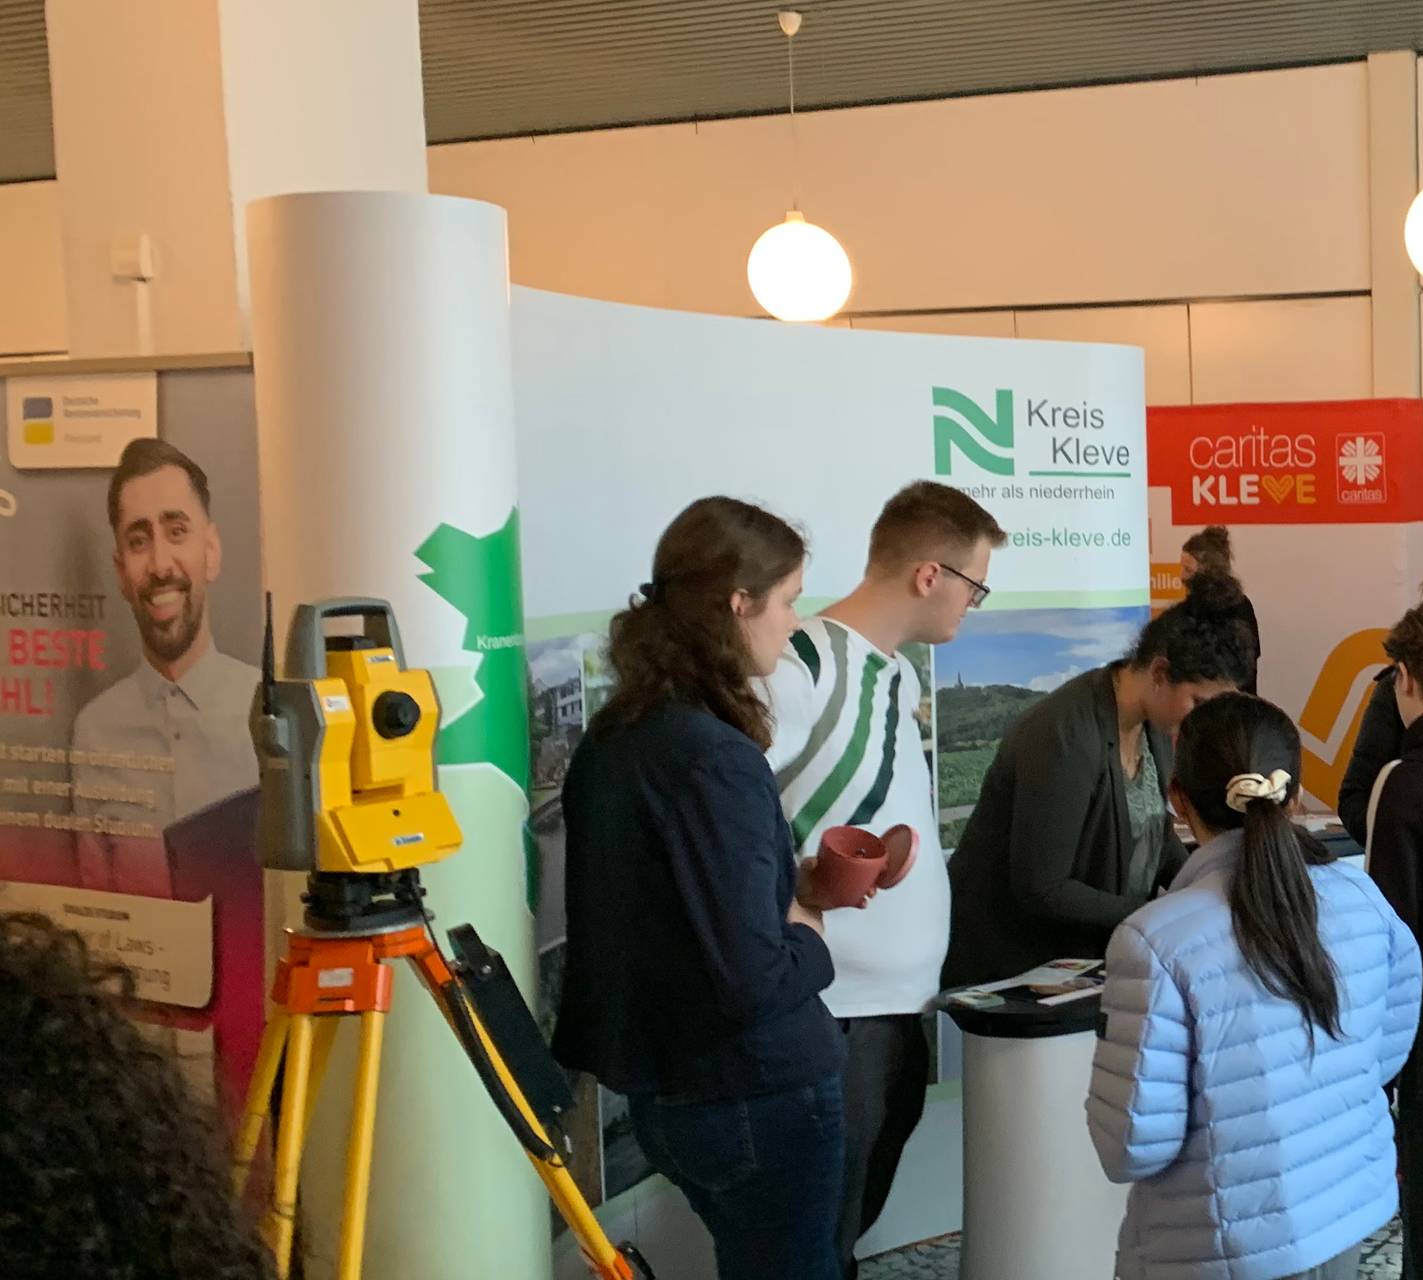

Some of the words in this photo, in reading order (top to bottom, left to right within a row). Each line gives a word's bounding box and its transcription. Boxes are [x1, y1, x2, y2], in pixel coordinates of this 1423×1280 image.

[1026, 398, 1105, 429] Kreis
[1051, 436, 1131, 466] Kleve
[1190, 424, 1317, 469] caritas
[958, 483, 997, 500] mehr
[1001, 484, 1024, 500] als
[1029, 484, 1115, 500] niederrhein
[1341, 487, 1383, 501] caritas
[1004, 527, 1132, 547] reis-kleve.de
[8, 628, 109, 671] BESTE
